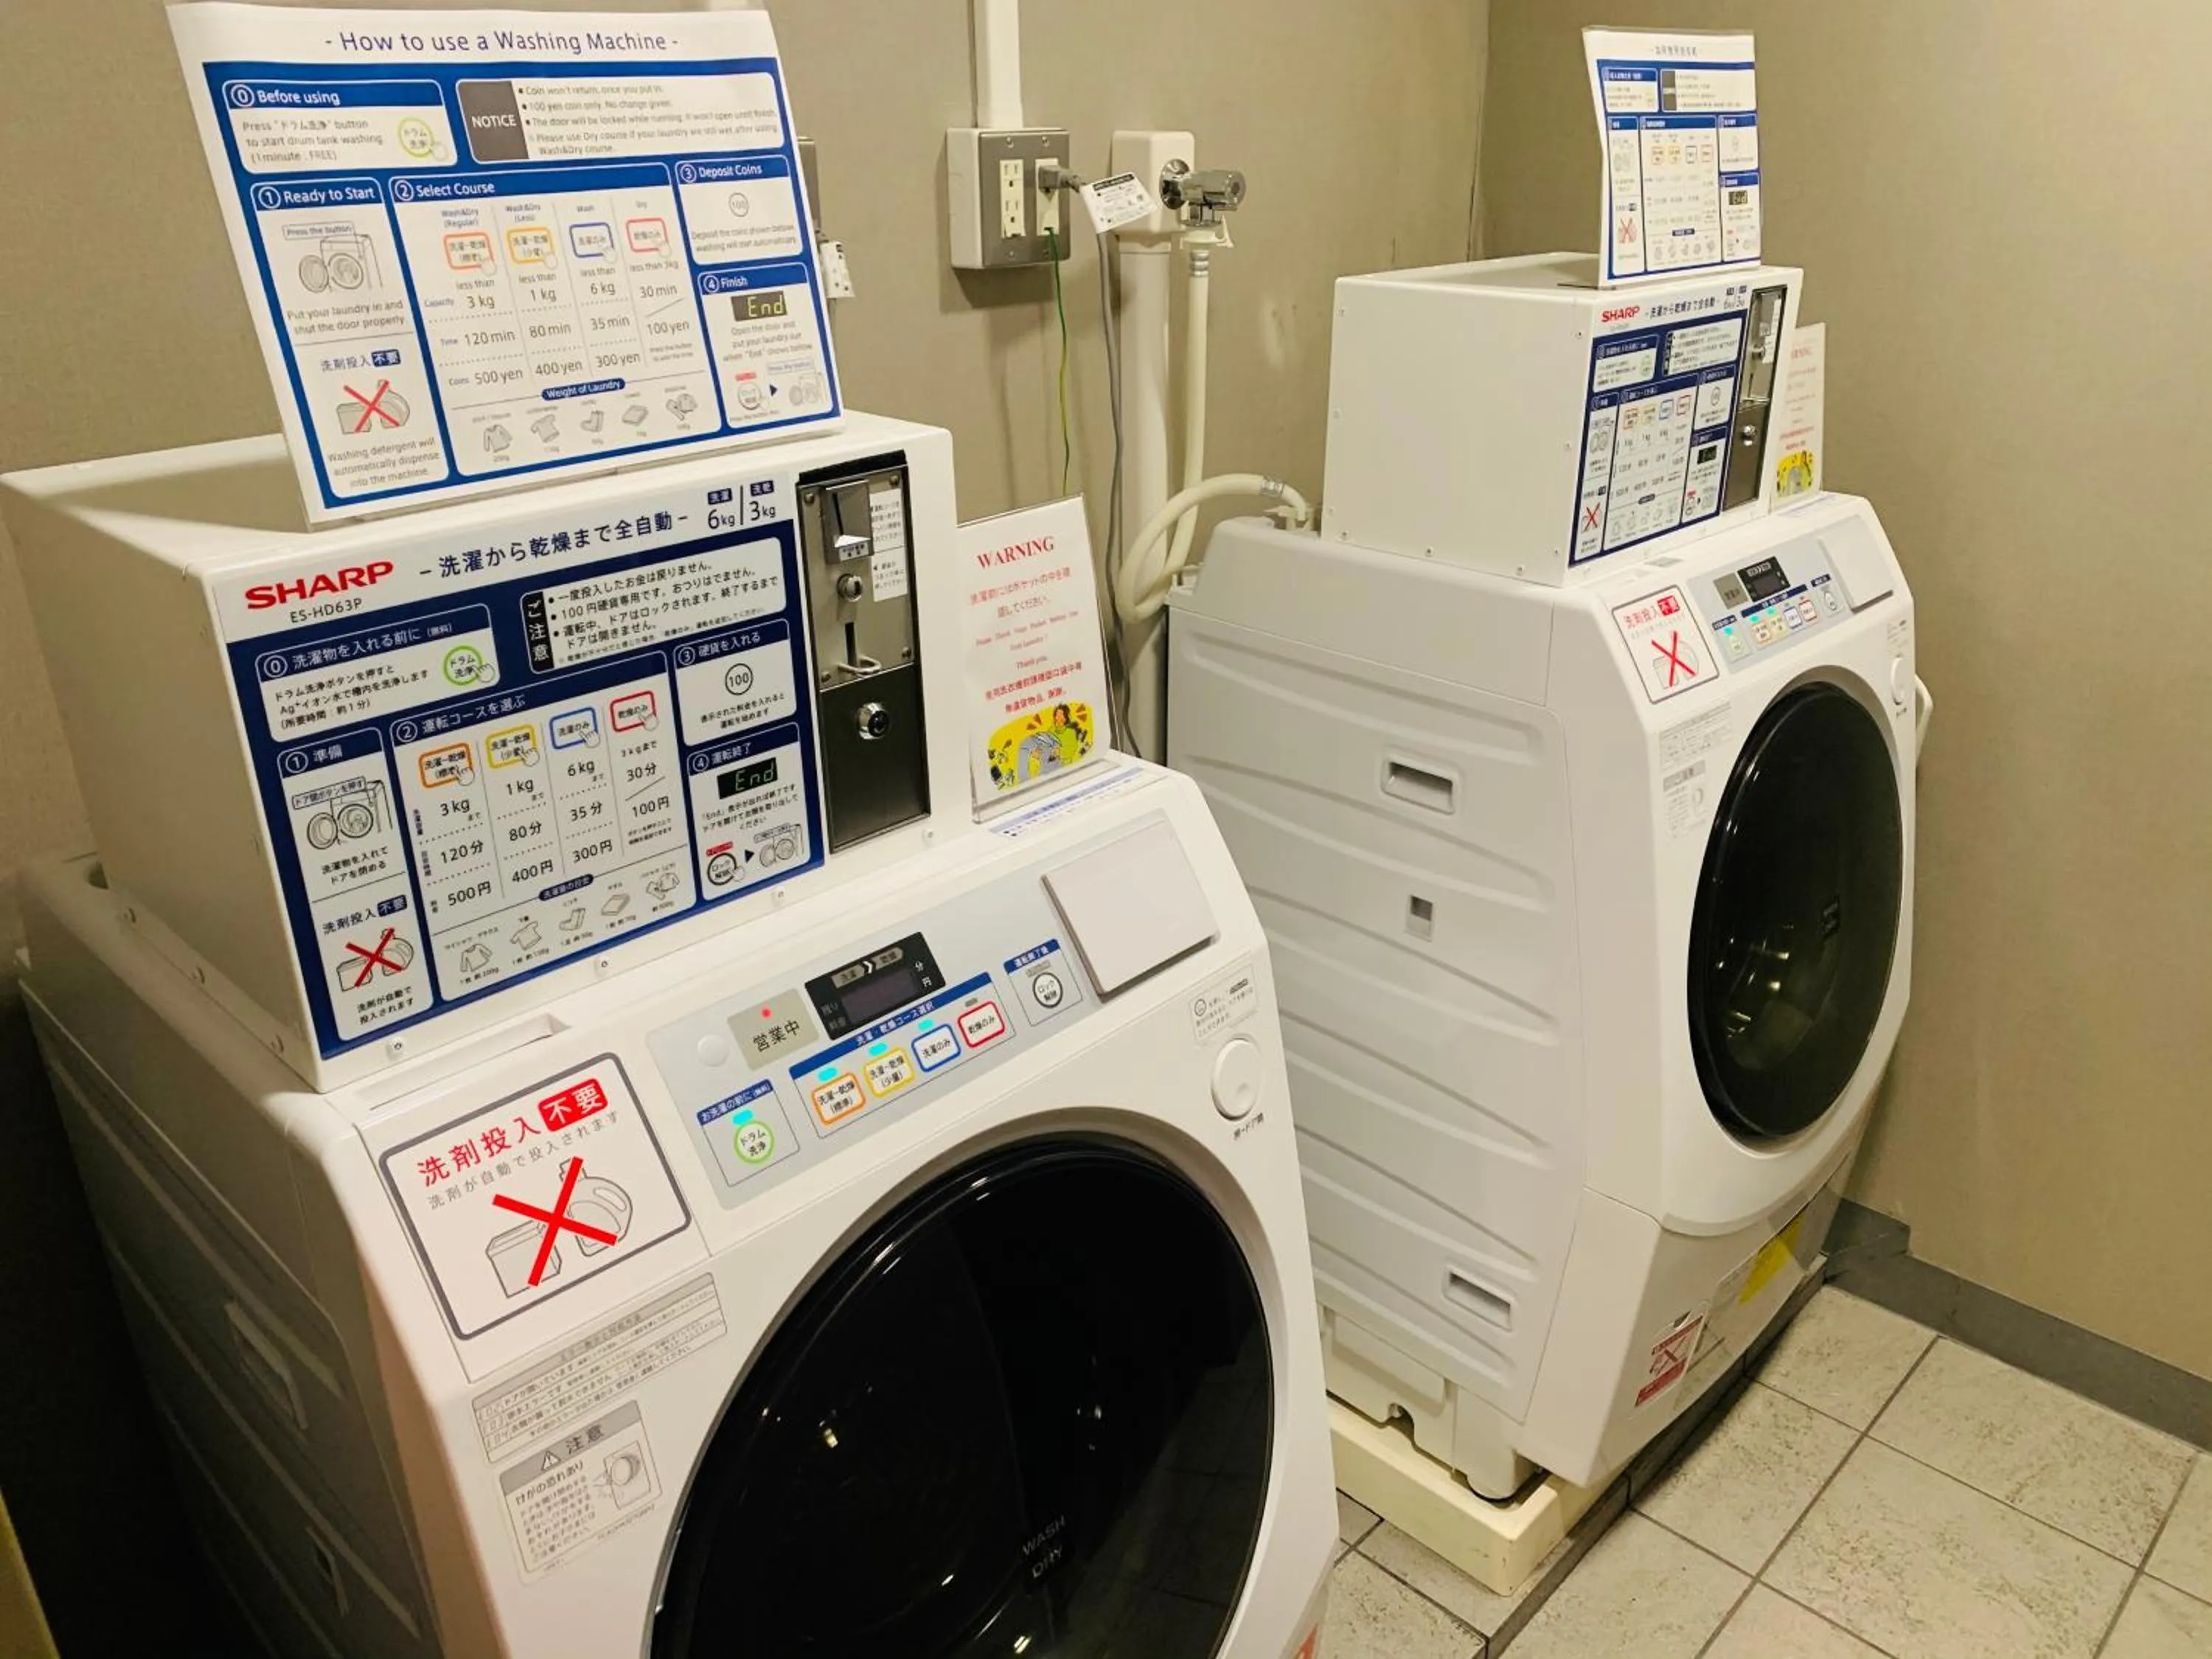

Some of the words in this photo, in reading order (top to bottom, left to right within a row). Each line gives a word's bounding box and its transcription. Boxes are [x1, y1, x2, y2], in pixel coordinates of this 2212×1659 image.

[341, 32, 393, 52] How
[402, 34, 424, 51] to
[432, 35, 469, 52] use
[477, 35, 488, 50] a
[494, 31, 582, 55] Washing
[586, 32, 667, 51] Machine
[258, 89, 301, 105] Before
[302, 91, 340, 106] using
[243, 120, 272, 131] Press
[334, 119, 369, 130] button
[471, 114, 516, 128] NOTICE
[246, 137, 257, 147] to
[261, 135, 284, 146] start
[288, 135, 313, 146] drum
[317, 134, 338, 145] tank
[341, 133, 383, 147] washing
[699, 165, 734, 178] Deposit
[735, 164, 762, 176] Coins
[285, 189, 325, 205] Ready
[330, 188, 341, 201] to
[345, 186, 375, 200] Start
[417, 183, 451, 198] Select
[453, 181, 495, 196] Course
[591, 282, 599, 294] 6
[600, 281, 616, 296] kg
[721, 276, 748, 288] Finish
[424, 298, 455, 308] Capacity
[467, 296, 476, 308] 3
[479, 295, 495, 309] kg
[541, 288, 557, 302] kg
[288, 310, 305, 320] Put
[307, 308, 329, 320] your
[332, 304, 369, 317] laundry
[372, 303, 383, 312] in
[385, 300, 403, 310] and
[748, 294, 785, 318] End
[1601, 305, 1641, 322] SHARP
[318, 321, 334, 332] the
[338, 319, 359, 330] door
[364, 316, 405, 329] properly
[440, 336, 459, 346] Time
[321, 356, 371, 372] 洗剤投入
[373, 351, 400, 366] 不要
[448, 376, 470, 387] Coins
[546, 386, 577, 399] Weight
[588, 380, 622, 394] Laundry
[328, 448, 369, 462] Washing
[371, 441, 417, 456] detergent
[420, 437, 435, 447] will
[334, 458, 397, 476] automatically
[399, 451, 440, 466] dispense
[349, 477, 367, 488] into
[370, 475, 386, 484] the
[388, 467, 428, 481] machine
[707, 509, 735, 529] 6kg
[750, 499, 776, 521] 3kg
[438, 511, 675, 579] 洗濯から乾燥まで全自動
[976, 535, 1056, 570] WARNING
[245, 560, 394, 611] SHARP
[291, 597, 363, 623] ES-HD63P
[527, 601, 550, 662] ご注意
[292, 629, 422, 669] 洗濯物を入れる前に
[699, 633, 761, 658] 硬貨を入れる
[451, 654, 476, 666] ドラム
[275, 664, 394, 702] ドラム洗浄ボタンを押すと
[728, 672, 750, 687] 100
[422, 695, 526, 734] 運転コースを選ぶ
[618, 704, 648, 720] 乾燥のみ
[700, 692, 785, 724] 表示された料金を入れると
[720, 708, 770, 729] 運転を始めます
[558, 720, 591, 736] 洗濯のみ
[313, 745, 343, 763] 準備
[712, 742, 751, 765] 運転終了
[626, 762, 658, 783] 30分
[736, 766, 774, 792] End
[570, 801, 603, 822] 35分
[633, 796, 671, 818] 100円
[509, 821, 543, 841] 80分
[739, 815, 768, 832] ください
[321, 846, 389, 876] 洗濯物を入れて
[440, 839, 484, 865] 120分
[572, 839, 613, 863] 300円
[330, 860, 387, 885] ドアを閉める
[512, 860, 554, 883] 400円
[447, 881, 492, 907] 500円
[323, 907, 377, 935] 洗剤投入
[379, 897, 407, 917] 不要
[914, 961, 924, 972] 分
[922, 977, 933, 988] 円
[1037, 980, 1056, 995] ロック
[357, 986, 413, 1013] 洗剤が自動で
[360, 997, 414, 1025] 投入されます
[967, 1013, 995, 1034] 乾燥のみ
[752, 1019, 801, 1054] 営業中
[922, 1037, 952, 1060] 洗濯のみ
[701, 1092, 753, 1122] お洗濯の前に
[417, 1115, 542, 1188] 洗剤投入
[543, 1085, 605, 1125] 不要
[740, 1128, 766, 1147] ドラム
[748, 1141, 767, 1157] 洗浄
[428, 1109, 621, 1211] 洗剤が自動で投入されます
[566, 1423, 605, 1455] 注意
[1022, 1514, 1067, 1556] WASH
